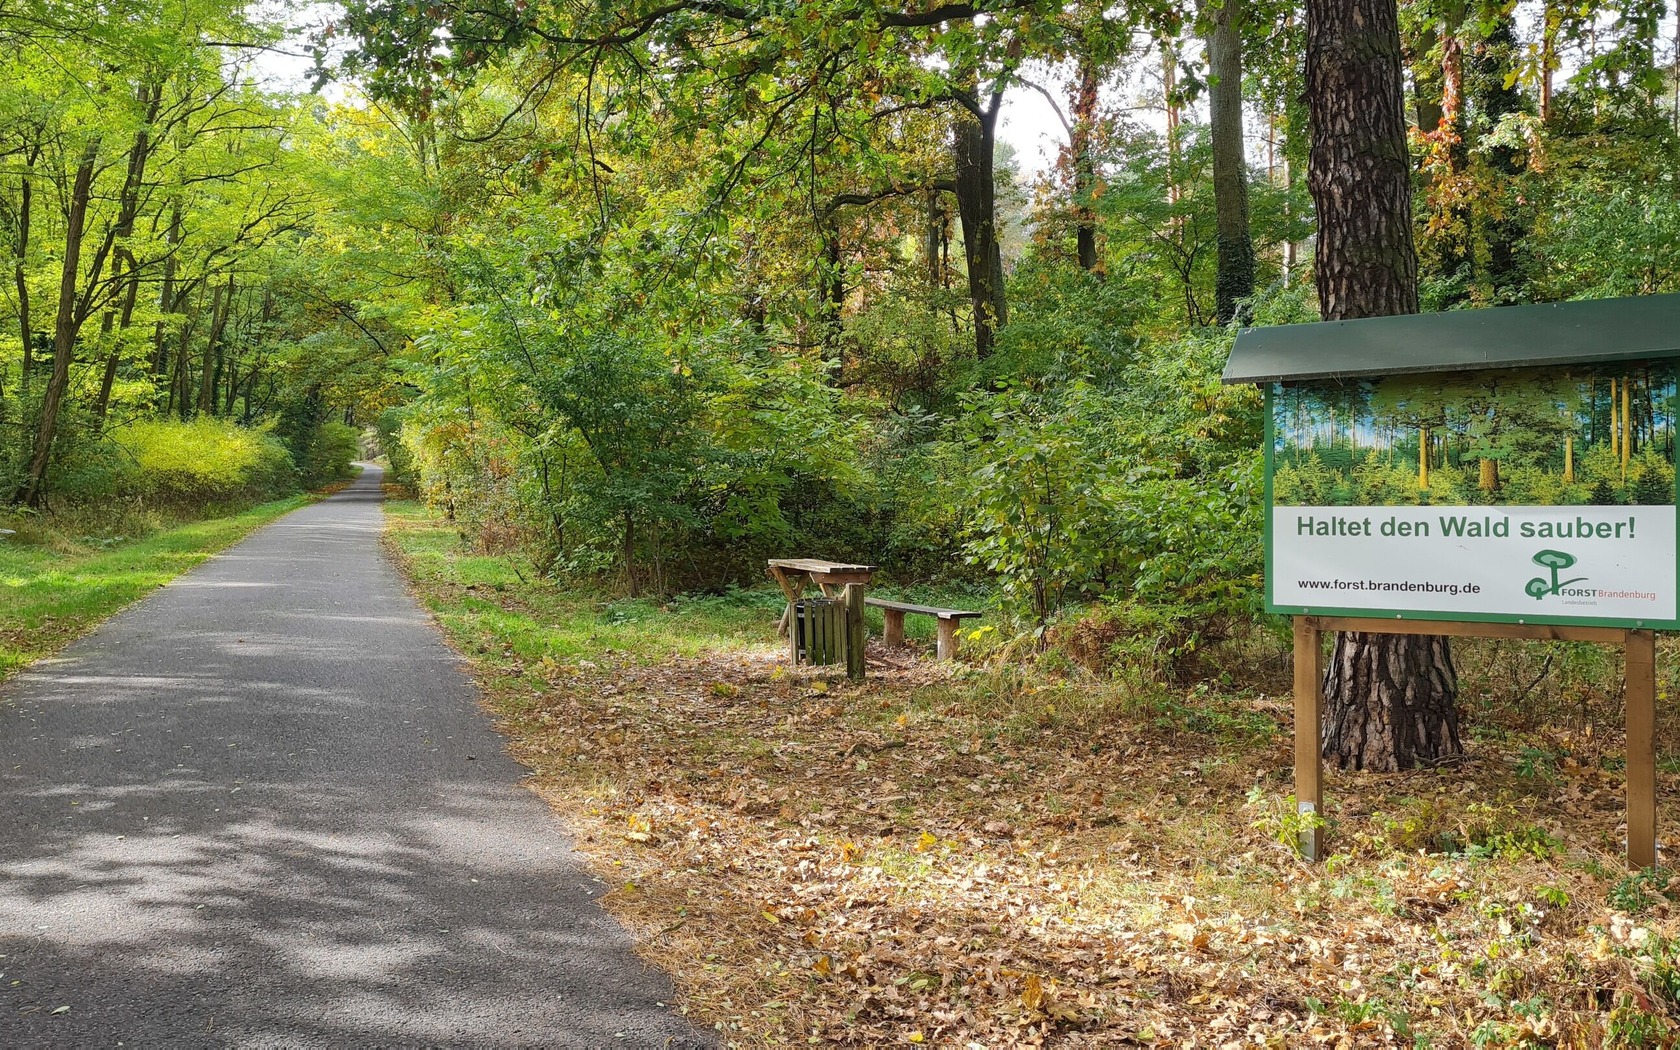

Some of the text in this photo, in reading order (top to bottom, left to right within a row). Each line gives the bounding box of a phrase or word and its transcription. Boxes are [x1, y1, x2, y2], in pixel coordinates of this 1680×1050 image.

[1296, 516, 1636, 539] Haltet den Wald sauber!
[1298, 578, 1481, 595] www.forst.brandenburg.de
[1562, 588, 1656, 601] FORST Brandenburg
